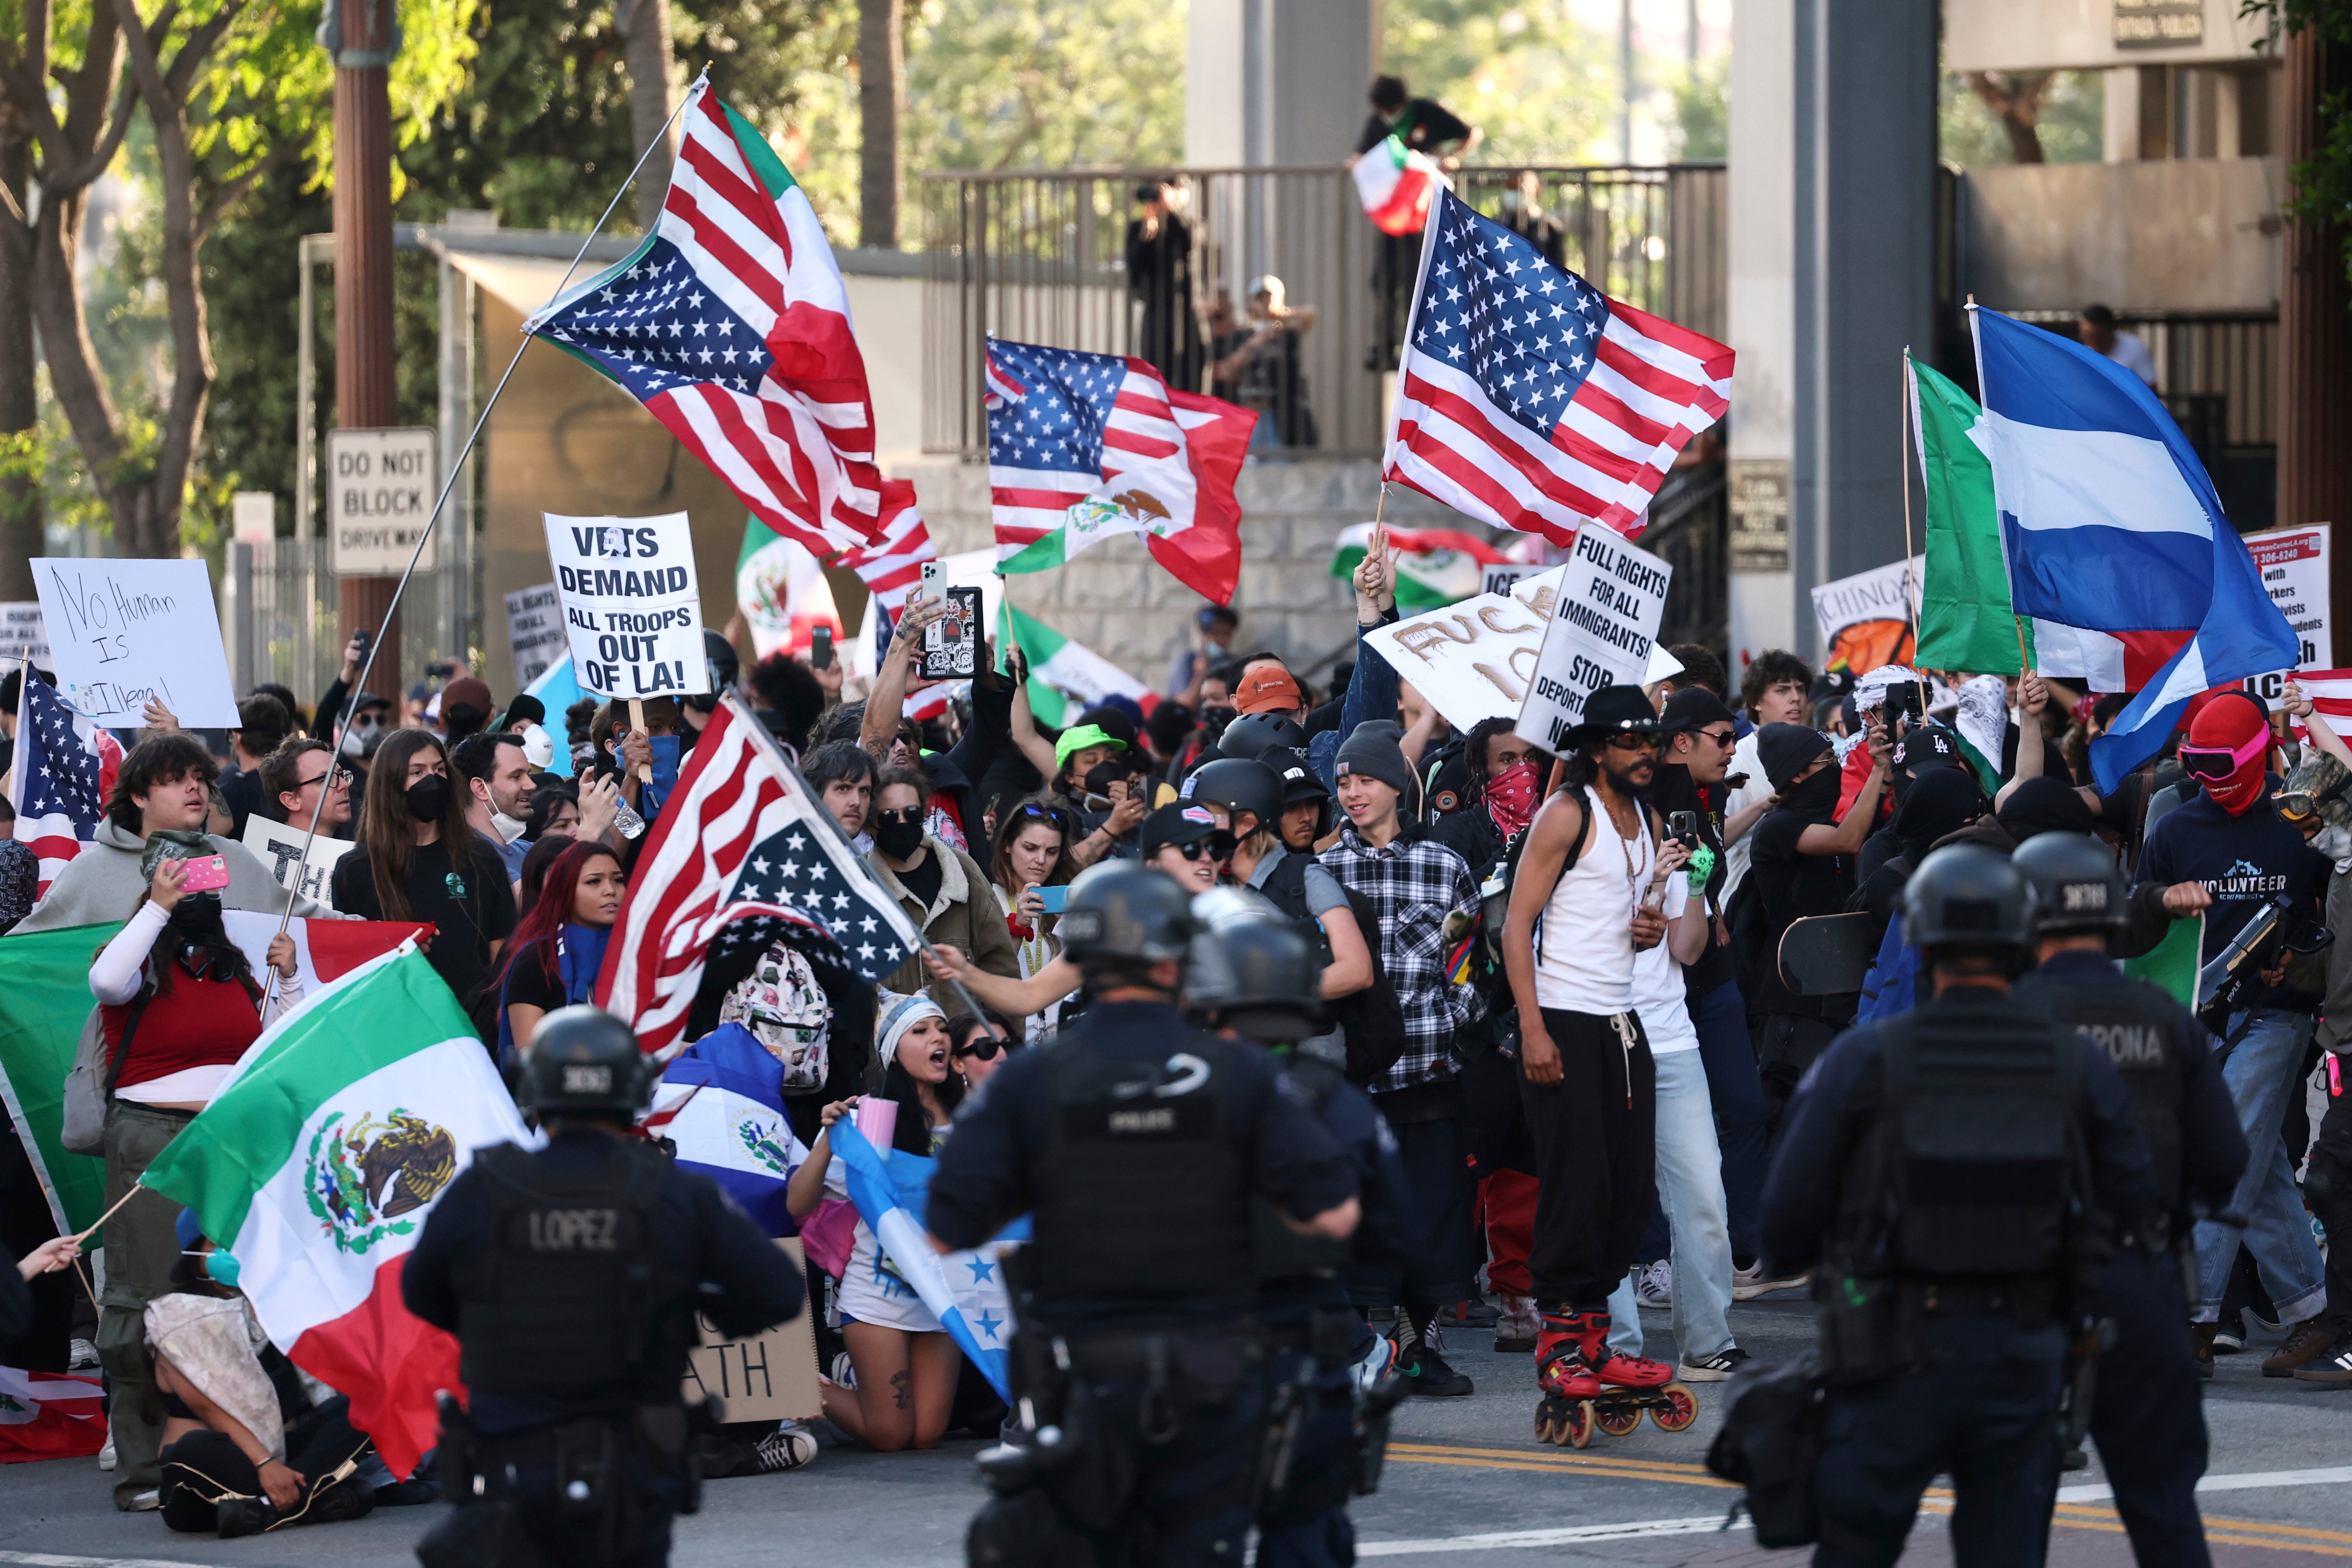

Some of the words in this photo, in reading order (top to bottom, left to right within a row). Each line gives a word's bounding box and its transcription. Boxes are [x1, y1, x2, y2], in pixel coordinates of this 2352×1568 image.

[339, 450, 370, 477] DO
[382, 449, 424, 477] NOT
[345, 488, 423, 516] BLOCK
[340, 528, 425, 550] DRIVEWA
[1577, 533, 1614, 572] FULL
[1615, 553, 1666, 599] RIGHTS
[2264, 568, 2286, 581] with
[559, 565, 688, 597] DEMAND
[107, 576, 177, 631] Human
[1589, 576, 1615, 607] FOR
[1613, 591, 1640, 621] ALL
[2279, 604, 2305, 616] ivists
[570, 607, 600, 631] ALL
[605, 607, 691, 633] TROOPS
[1559, 597, 1652, 660] IMMIGRANTS!
[92, 635, 129, 663] IS
[599, 635, 659, 662] OUT
[586, 660, 620, 692] OF
[632, 660, 685, 694] LA!
[1473, 647, 1540, 702] IC
[1570, 654, 1614, 690] STOP
[2247, 672, 2284, 700] IC
[1933, 735, 1949, 753] LA
[2198, 875, 2286, 893] VOLUNTEER
[2227, 980, 2242, 1003] PYLE
[530, 1209, 618, 1248] LOPEZ
